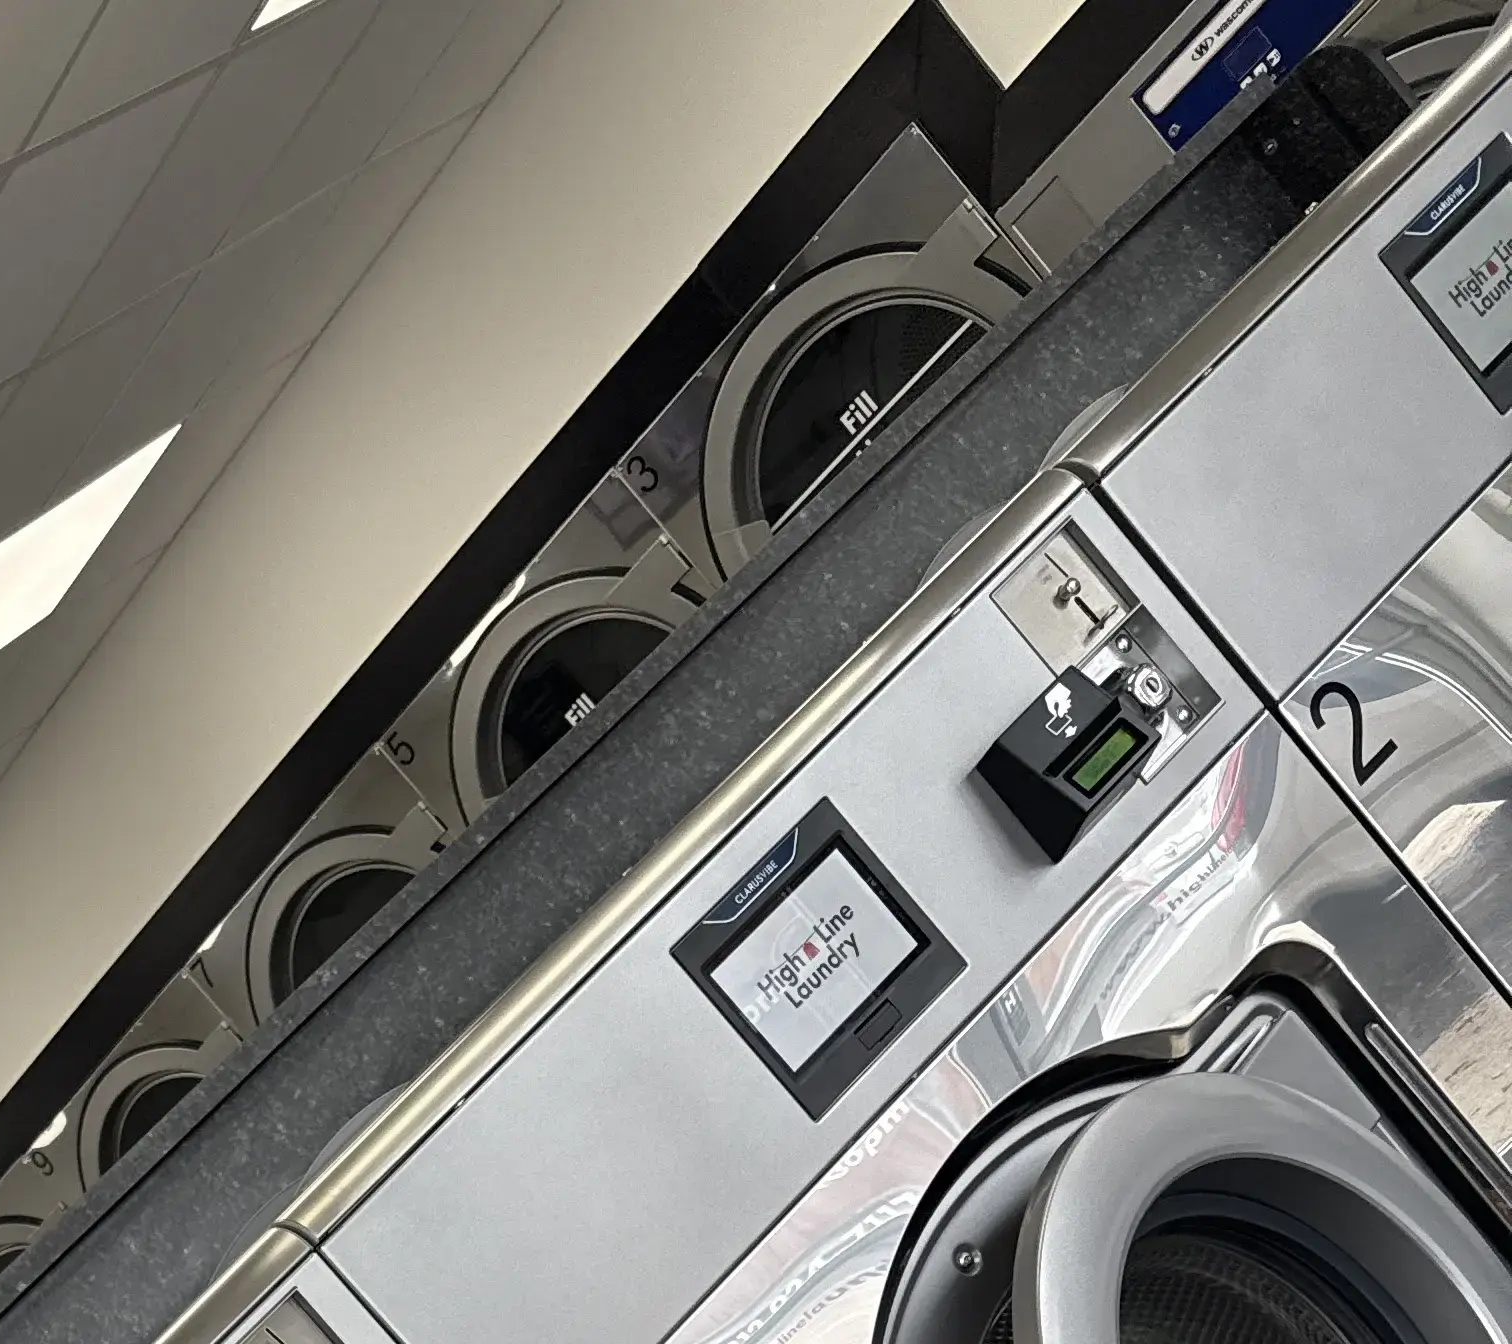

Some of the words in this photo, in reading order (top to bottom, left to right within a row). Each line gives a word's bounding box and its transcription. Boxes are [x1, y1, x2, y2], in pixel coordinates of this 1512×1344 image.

[1430, 184, 1466, 222] CLARUSVIBE
[1448, 267, 1489, 308] High
[839, 390, 879, 435] Fill
[627, 455, 659, 493] 3
[564, 693, 595, 728] Fill
[387, 732, 414, 765] 5
[1310, 681, 1399, 786] 2
[734, 859, 779, 905] CLARUSVIBE
[189, 957, 214, 988] 7
[757, 951, 806, 1002] High
[813, 905, 854, 944] Line
[784, 933, 860, 1009] Laundry
[31, 1151, 54, 1176] 9
